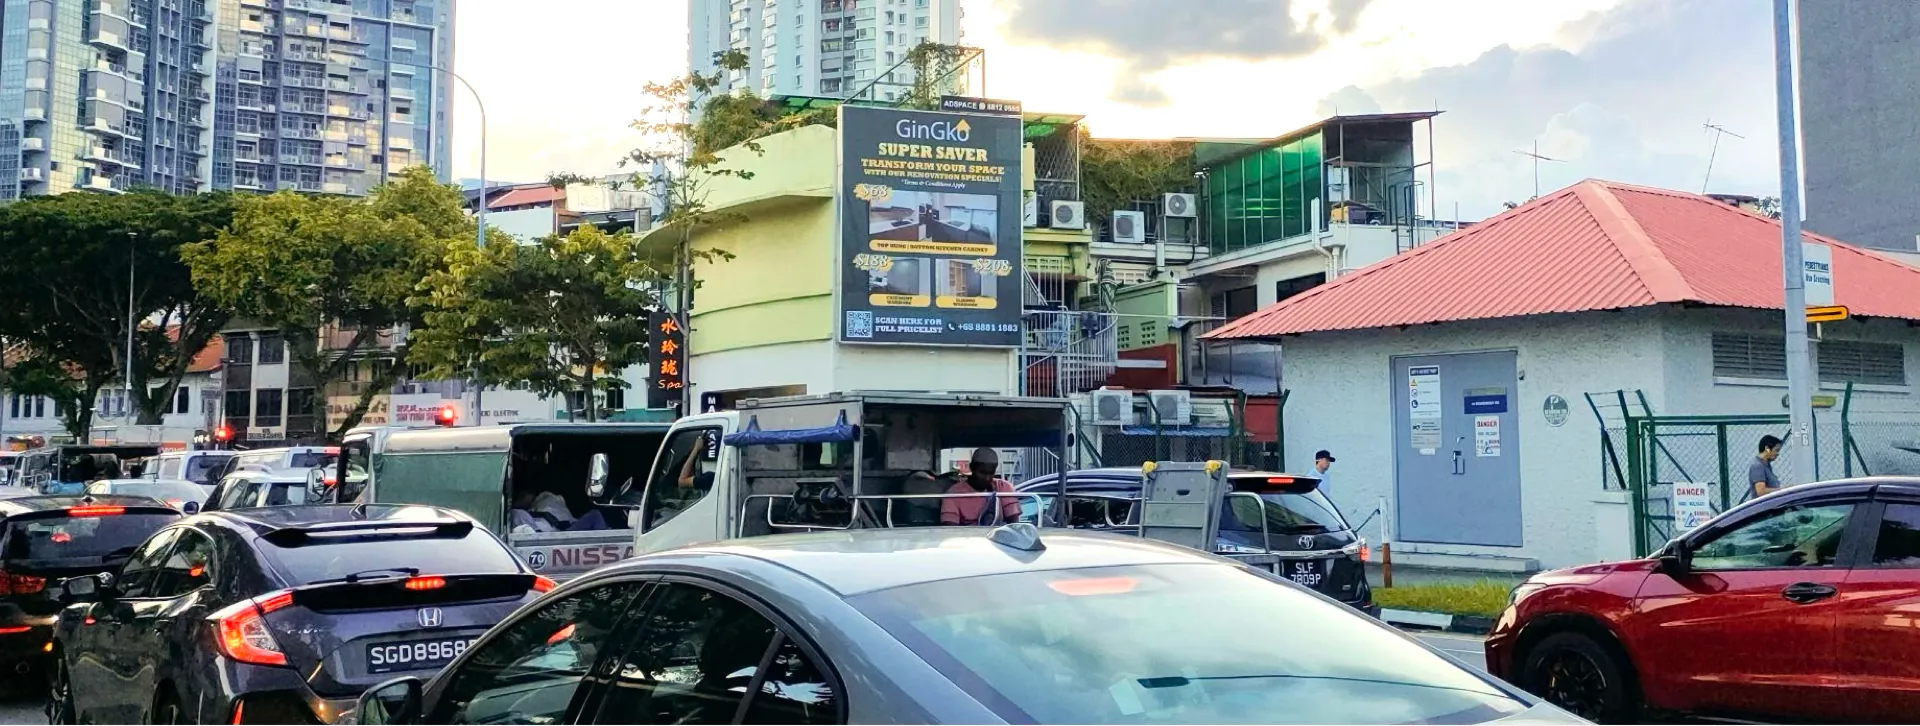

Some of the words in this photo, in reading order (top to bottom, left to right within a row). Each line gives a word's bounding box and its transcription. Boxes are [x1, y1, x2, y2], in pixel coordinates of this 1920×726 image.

[943, 100, 977, 110] ADSPACE
[896, 119, 971, 142] GinGko
[878, 142, 933, 158] SUPER
[936, 146, 988, 162] SAVER
[861, 158, 934, 172] TRANSFORM
[936, 163, 966, 173] YOUR
[968, 164, 1005, 175] SPACE
[864, 169, 886, 177] WITH
[907, 171, 959, 181] RENOVATION
[862, 184, 889, 198] $68
[855, 254, 888, 267] $188
[975, 258, 1010, 272] $208
[875, 317, 897, 325] SCAN
[899, 317, 923, 325] HERE
[924, 318, 942, 326] FOR
[875, 325, 896, 333] FULL
[897, 326, 943, 334] PRICELIST
[958, 324, 974, 332] +65
[658, 379, 684, 391] Spa
[1677, 488, 1705, 496] DANGER
[530, 554, 544, 564] 70
[552, 546, 634, 567] NISSA
[1295, 562, 1313, 573] SLF
[1291, 574, 1321, 585] 7809P
